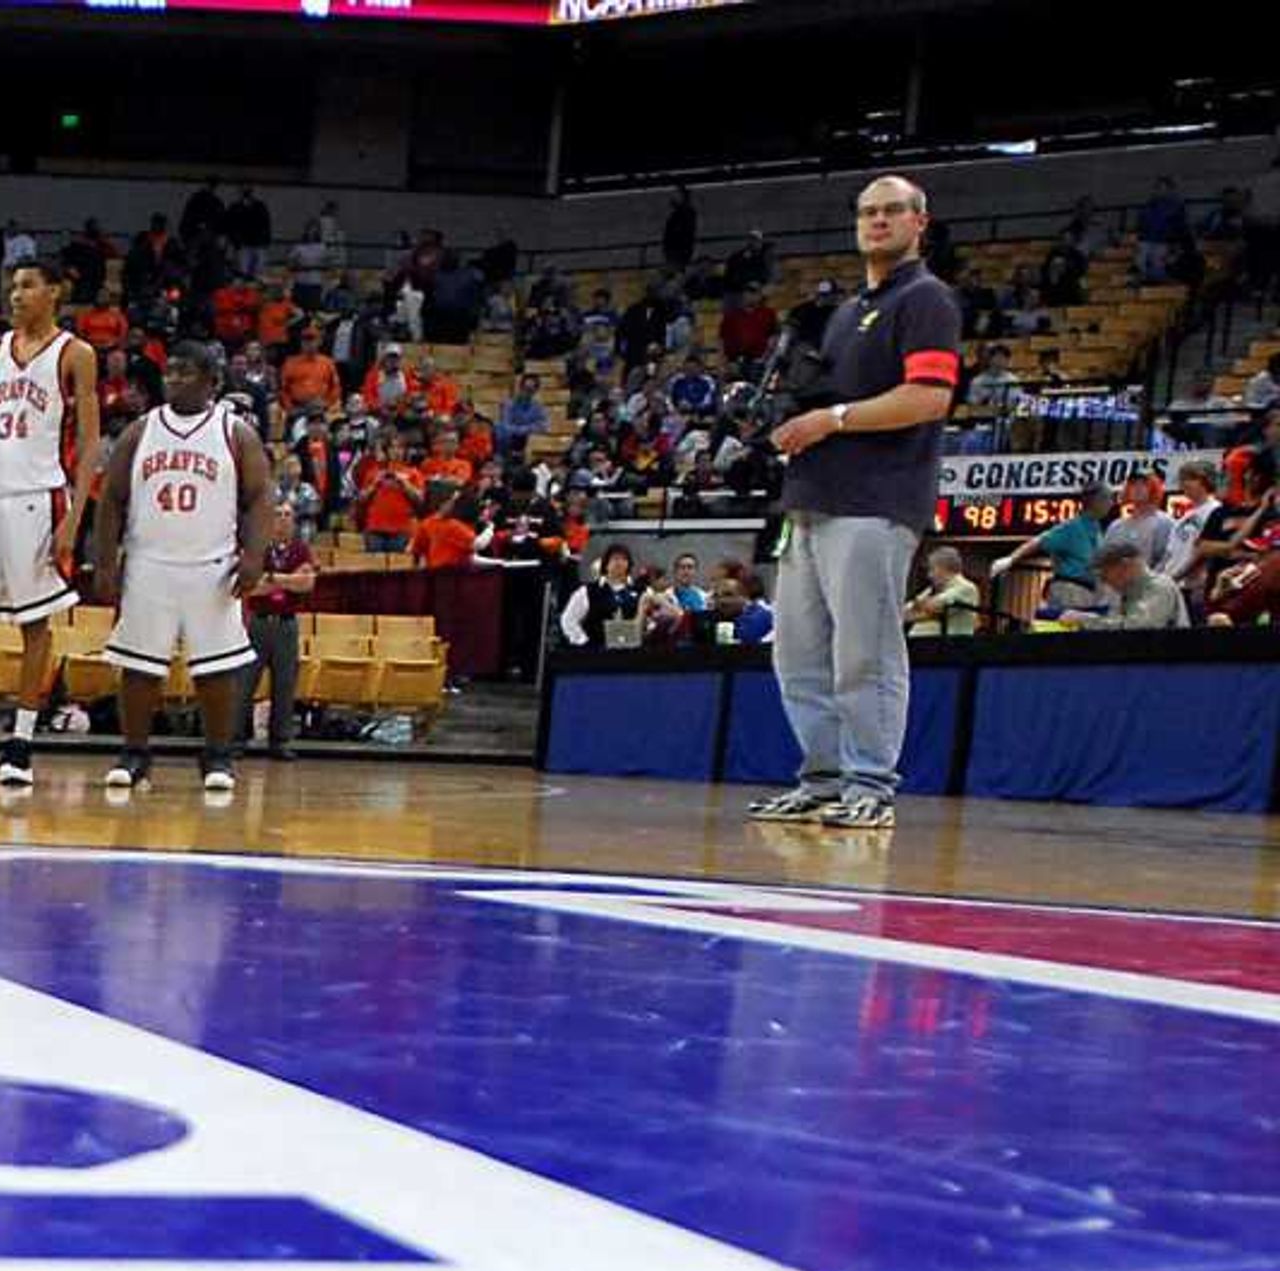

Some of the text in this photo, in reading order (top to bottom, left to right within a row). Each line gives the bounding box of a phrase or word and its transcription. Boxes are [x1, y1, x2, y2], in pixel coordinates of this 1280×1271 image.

[142, 449, 218, 482] BRAVES
[156, 482, 197, 512] 40
[1023, 498, 1083, 525] 15:0
